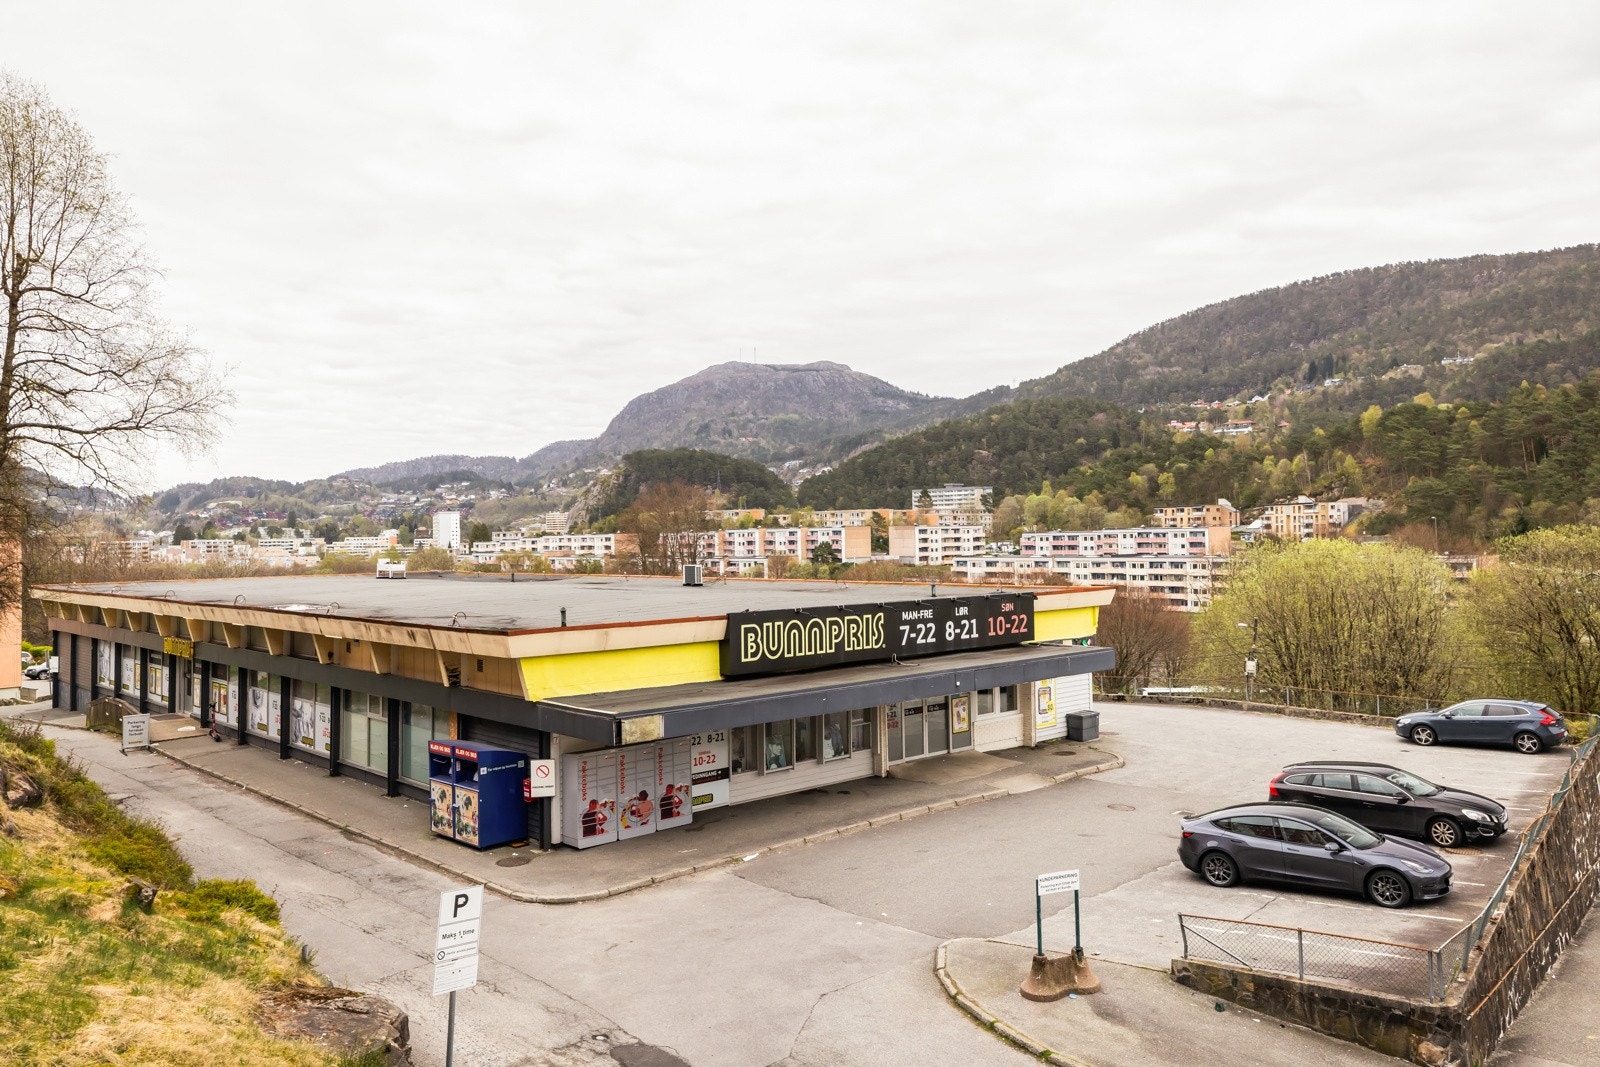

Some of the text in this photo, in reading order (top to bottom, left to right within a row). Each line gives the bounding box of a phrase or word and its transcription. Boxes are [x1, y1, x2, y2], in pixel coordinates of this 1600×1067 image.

[955, 606, 968, 616] LØR
[1002, 602, 1014, 612] SØN
[902, 610, 933, 620] MAN-FRE
[899, 614, 1028, 646] 7-22 8-21 10-22
[707, 732, 725, 743] 8-21
[693, 754, 716, 767] 10-22
[453, 894, 469, 918] P
[442, 930, 456, 940] Maks
